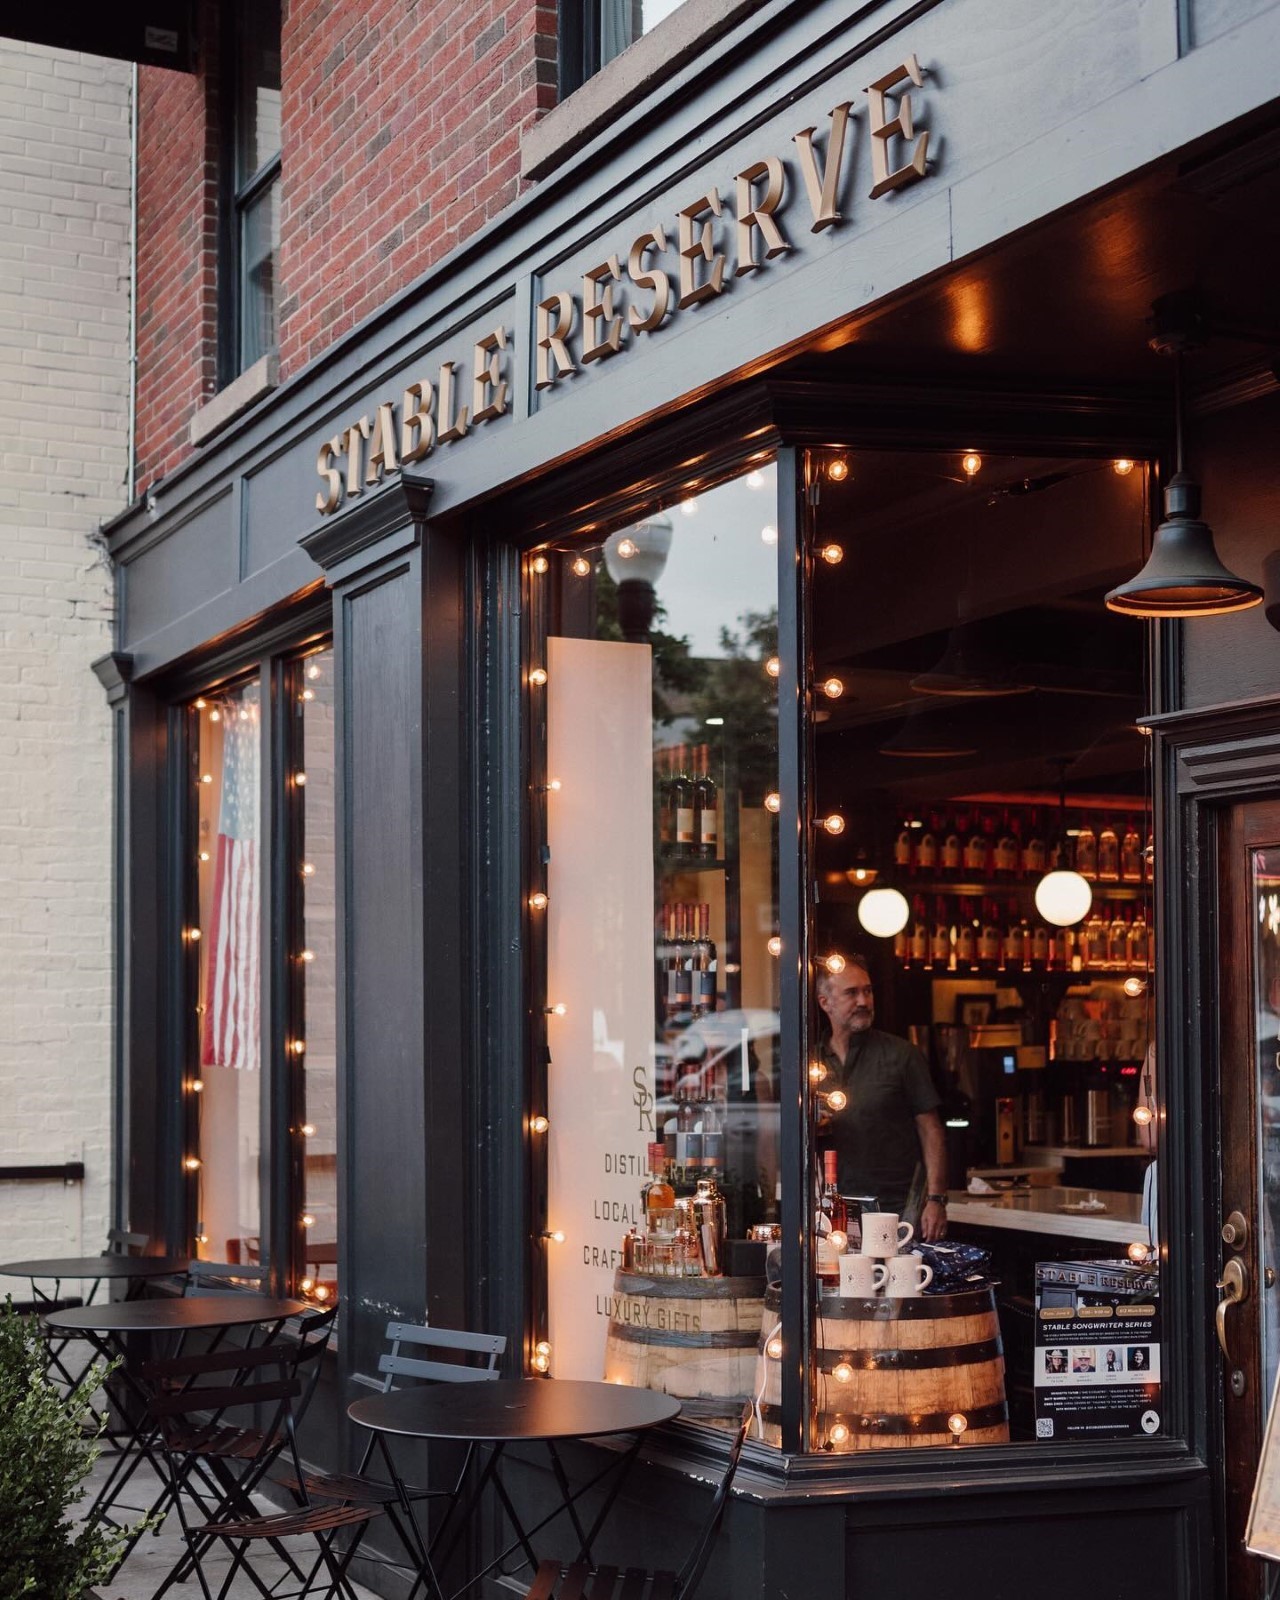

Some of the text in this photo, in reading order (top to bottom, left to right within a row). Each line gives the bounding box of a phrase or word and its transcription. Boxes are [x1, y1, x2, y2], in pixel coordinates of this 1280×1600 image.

[315, 54, 932, 516] STABLE RESERVE
[604, 1153, 687, 1183] DISTILRY
[594, 1199, 638, 1225] LOCAL
[583, 1245, 624, 1269] CRAFT
[1037, 1267, 1097, 1285] STABLE
[596, 1294, 701, 1332] LUXURY GIFTS
[1043, 1323, 1071, 1331] STABLE
[1072, 1322, 1123, 1330] SONGWRITER
